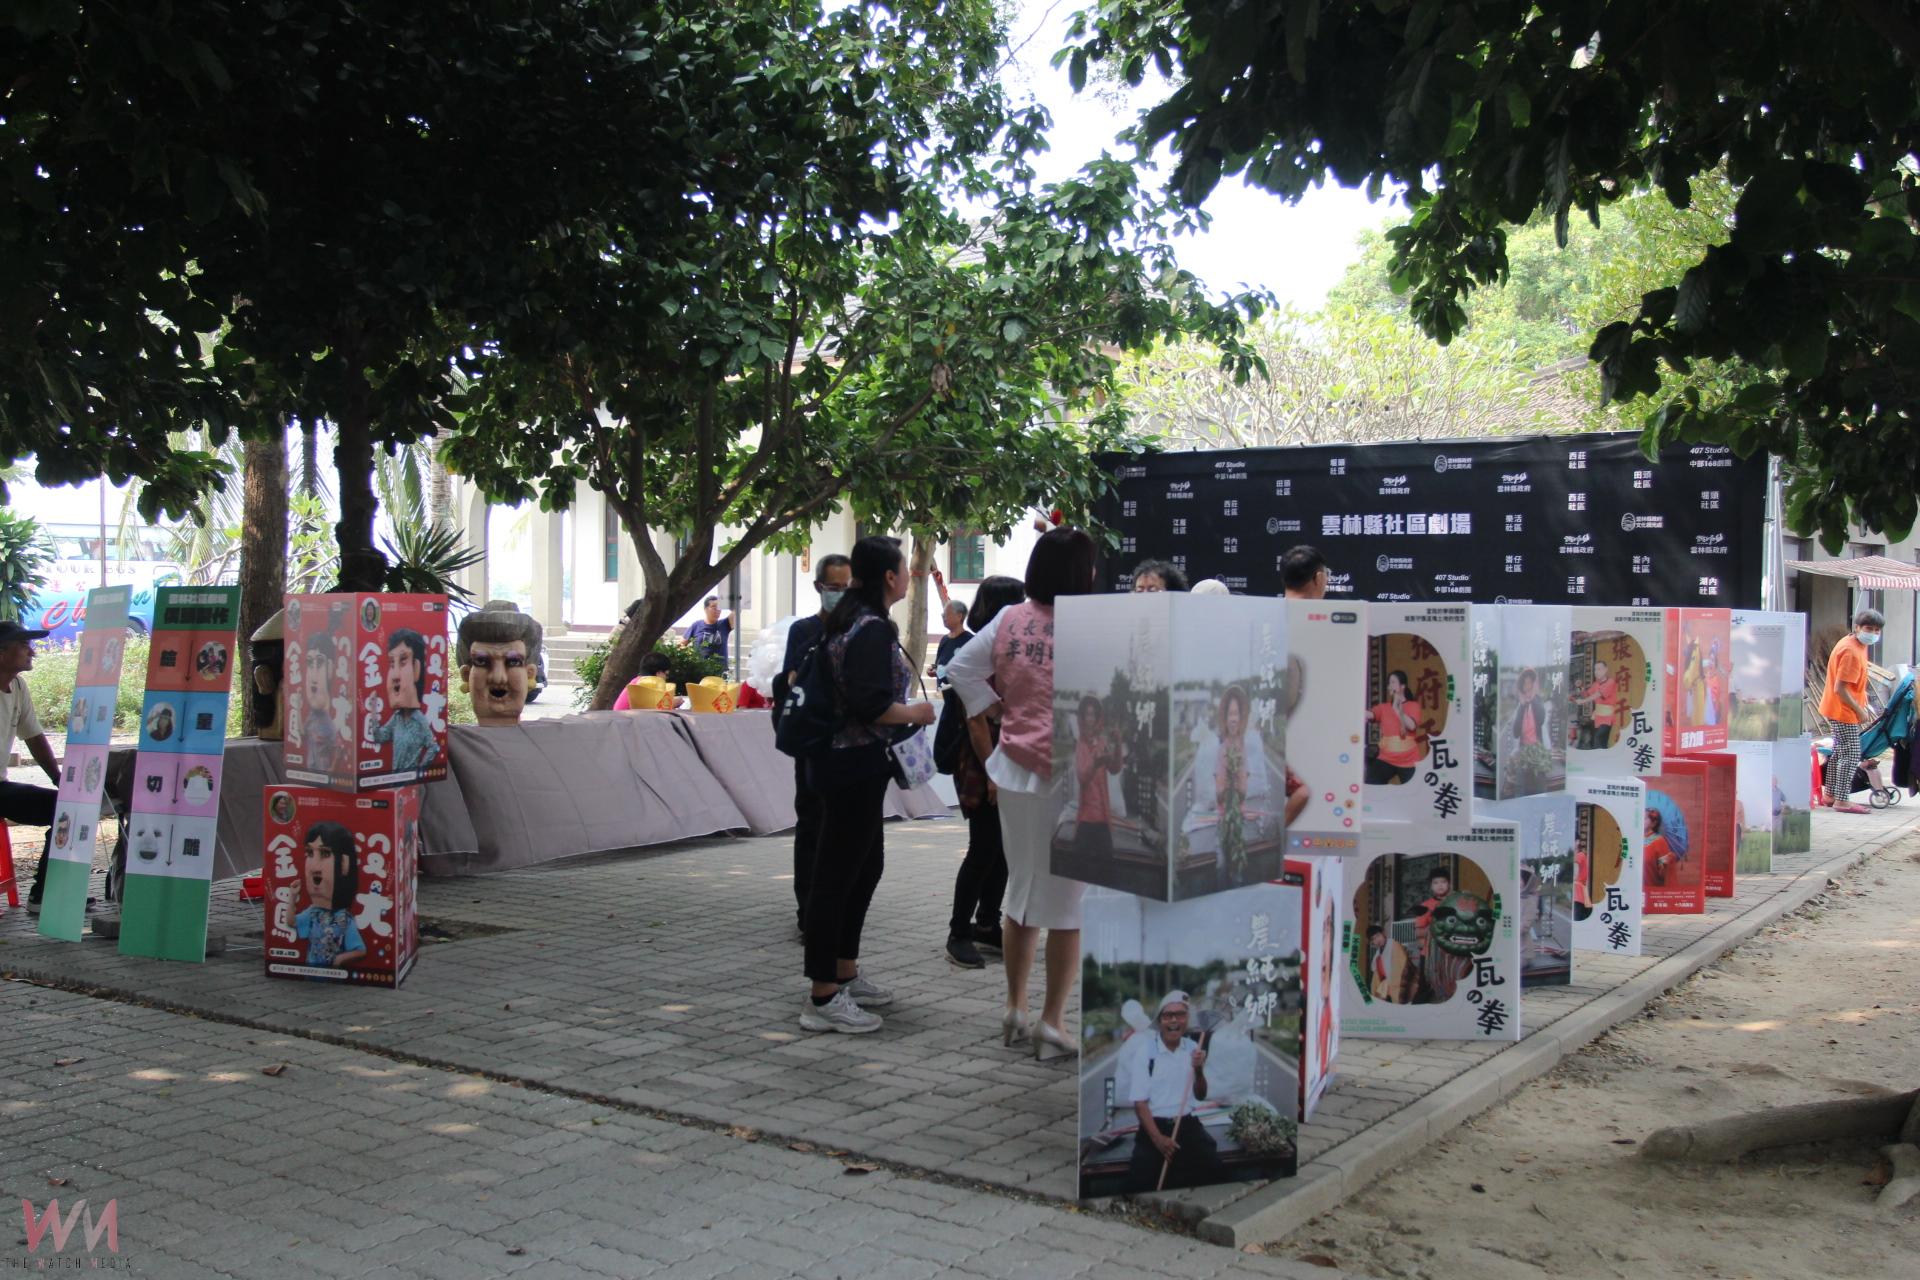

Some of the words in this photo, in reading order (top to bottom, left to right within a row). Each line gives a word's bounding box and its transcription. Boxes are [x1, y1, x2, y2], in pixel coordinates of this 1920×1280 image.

[1569, 461, 1586, 469] 社區
[1330, 467, 1345, 475] 社區
[1634, 471, 1652, 479] 田頭
[1634, 480, 1651, 488] 社區
[1276, 488, 1291, 496] 社區
[1568, 493, 1586, 502] 西莊
[1568, 503, 1586, 511] 社區
[1701, 501, 1719, 509] 社區
[1224, 508, 1238, 516] 社區
[1322, 513, 1472, 536] 雲林縣社區劇場
[1505, 524, 1522, 532] 社區
[1559, 546, 1594, 554] 雲林縣政府
[1632, 565, 1650, 573] 社區
[1699, 577, 1717, 585] 湖內
[1568, 586, 1584, 594] 社區
[1699, 587, 1717, 595] 社區
[1626, 711, 1655, 772] 瓦の拳
[1424, 739, 1463, 819] 瓦の拳
[1540, 813, 1562, 888] 農純鄉
[1600, 887, 1632, 950] 瓦の拳
[1243, 912, 1281, 1029] 農純鄉
[1466, 957, 1509, 1036] 瓦の拳
